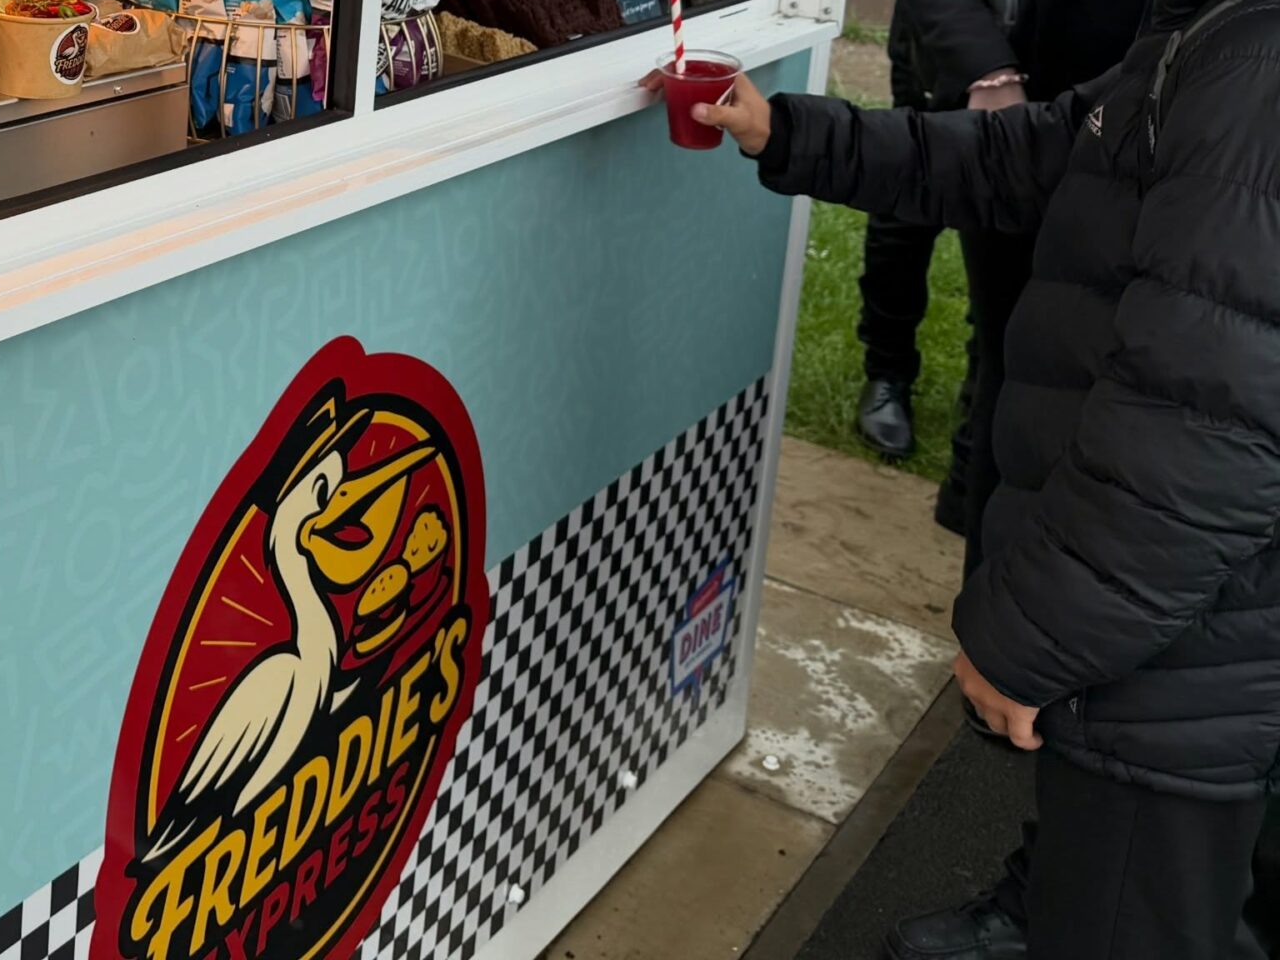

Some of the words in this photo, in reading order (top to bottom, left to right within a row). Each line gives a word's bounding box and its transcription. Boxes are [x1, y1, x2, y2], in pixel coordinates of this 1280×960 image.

[680, 601, 724, 665] DINE
[130, 617, 469, 960] FREDDIE'S
[201, 761, 410, 960] XPRESS
